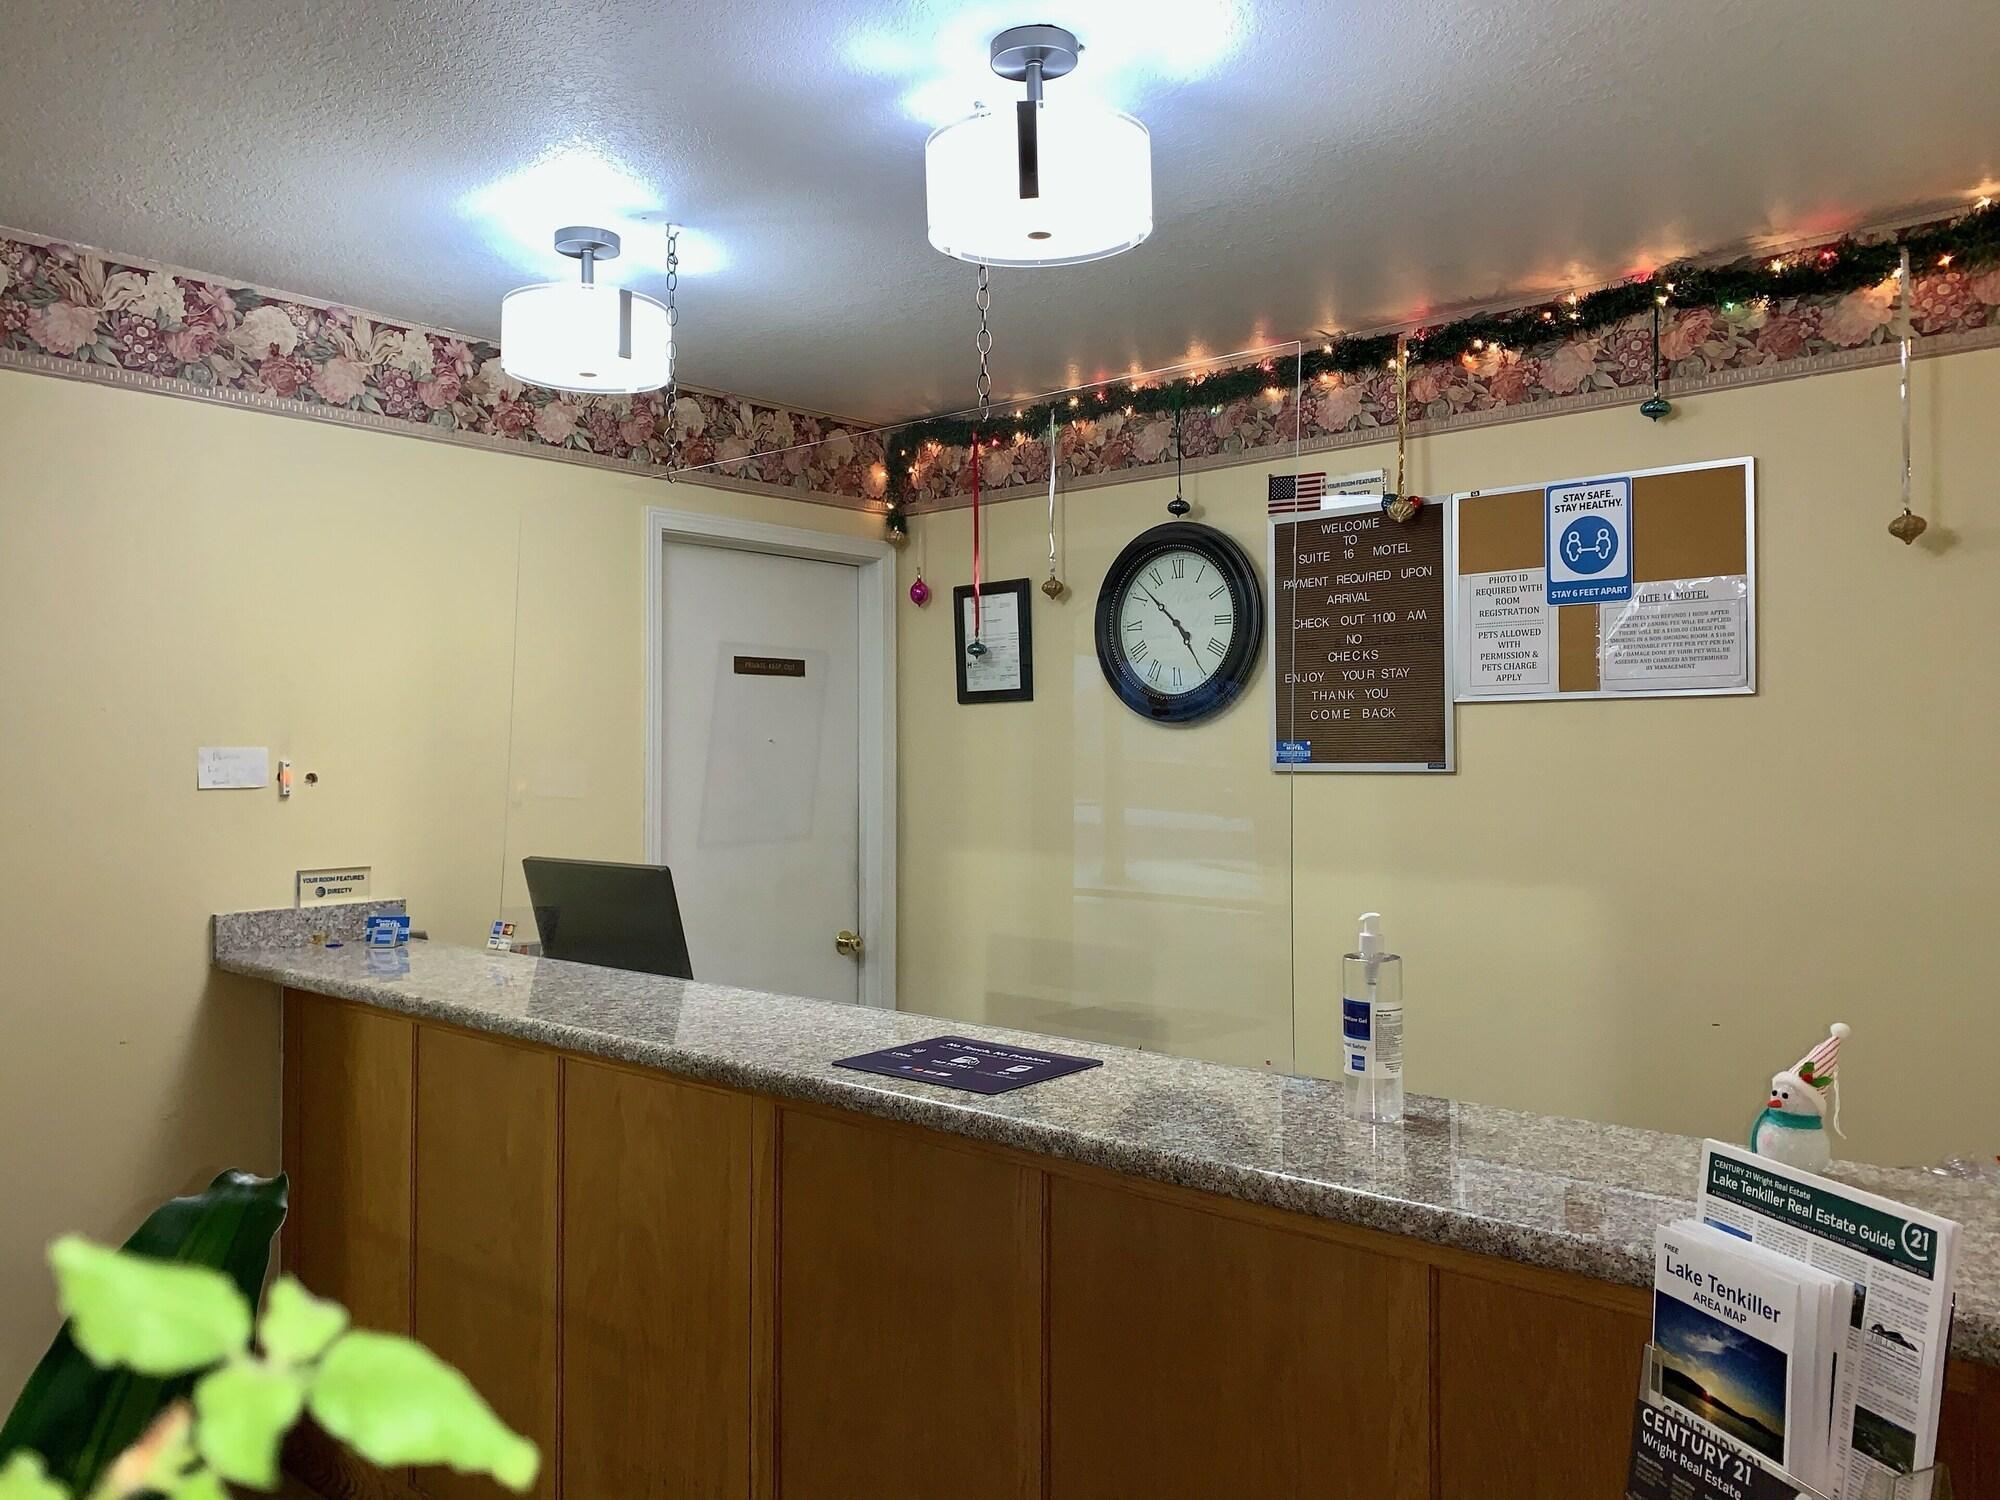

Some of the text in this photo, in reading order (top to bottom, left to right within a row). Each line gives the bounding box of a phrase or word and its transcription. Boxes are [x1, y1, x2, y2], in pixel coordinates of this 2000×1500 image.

[1327, 476, 1382, 489] YOUR ROOM FEATURES
[1563, 489, 1613, 503] STAY SAFE.
[1555, 498, 1623, 513] STAY HEALTHY.
[1321, 518, 1380, 535] WELCOME
[1343, 534, 1358, 546] TO
[1299, 543, 1412, 565] SUITE 16 MOTEL
[1283, 566, 1433, 591] PAYMENT REQUIRED UPON
[1489, 574, 1528, 584] PHOTO ID
[1476, 584, 1542, 596] REQUIRED WITH
[1551, 586, 1628, 598] STAY 6 FEET APART
[1327, 592, 1371, 605] ARRIVAL
[1496, 597, 1520, 606] ROOM
[1635, 593, 1660, 604] UITE
[1676, 590, 1709, 601] MOTEL
[1479, 606, 1540, 618] REGISTRATION
[1710, 609, 1730, 617] AFTER
[1293, 617, 1330, 630] CHECK
[1340, 614, 1366, 626] OUT
[1407, 609, 1427, 621] AM
[1681, 619, 1696, 627] WILL
[1706, 617, 1732, 625] APPLIED
[1346, 634, 1363, 645] NO
[1478, 628, 1541, 639] PETS ALLOWED
[1498, 640, 1521, 649] WITH
[1721, 637, 1735, 646] DAY
[1328, 649, 1379, 662] CHECKS
[1480, 650, 1539, 661] PERMISSION &
[1626, 650, 1650, 658] DAMAGE
[1651, 649, 1667, 657] DONE
[1706, 646, 1721, 654] WILL
[1639, 657, 1652, 665] AND
[1689, 654, 1729, 663] DETERMINED
[1482, 661, 1537, 671] PETS CHARGE
[1653, 663, 1696, 671] MANAGEMENT
[1284, 667, 1410, 684] ENJOY YOUR STAY
[1496, 674, 1522, 682] APPLY
[1312, 688, 1389, 701] THANK YOU
[1310, 707, 1396, 720] COME BACK
[336, 874, 365, 882] FEATURES
[327, 887, 353, 895] DIRECTV
[1714, 1159, 1811, 1201] CENTURY 21 Wright Real Estate
[1712, 1170, 1896, 1250] Lake Tenkiller Real Estate Guide
[1663, 1243, 1680, 1255] FREE
[1665, 1255, 1781, 1323] Lake Tenkiller
[1693, 1292, 1748, 1324] AREA MAP
[1642, 1408, 1731, 1470] CENTURY
[1733, 1460, 1753, 1487] 21
[1642, 1430, 1678, 1462] Wright
[1680, 1453, 1704, 1477] Real
[1704, 1469, 1742, 1500] Estate
